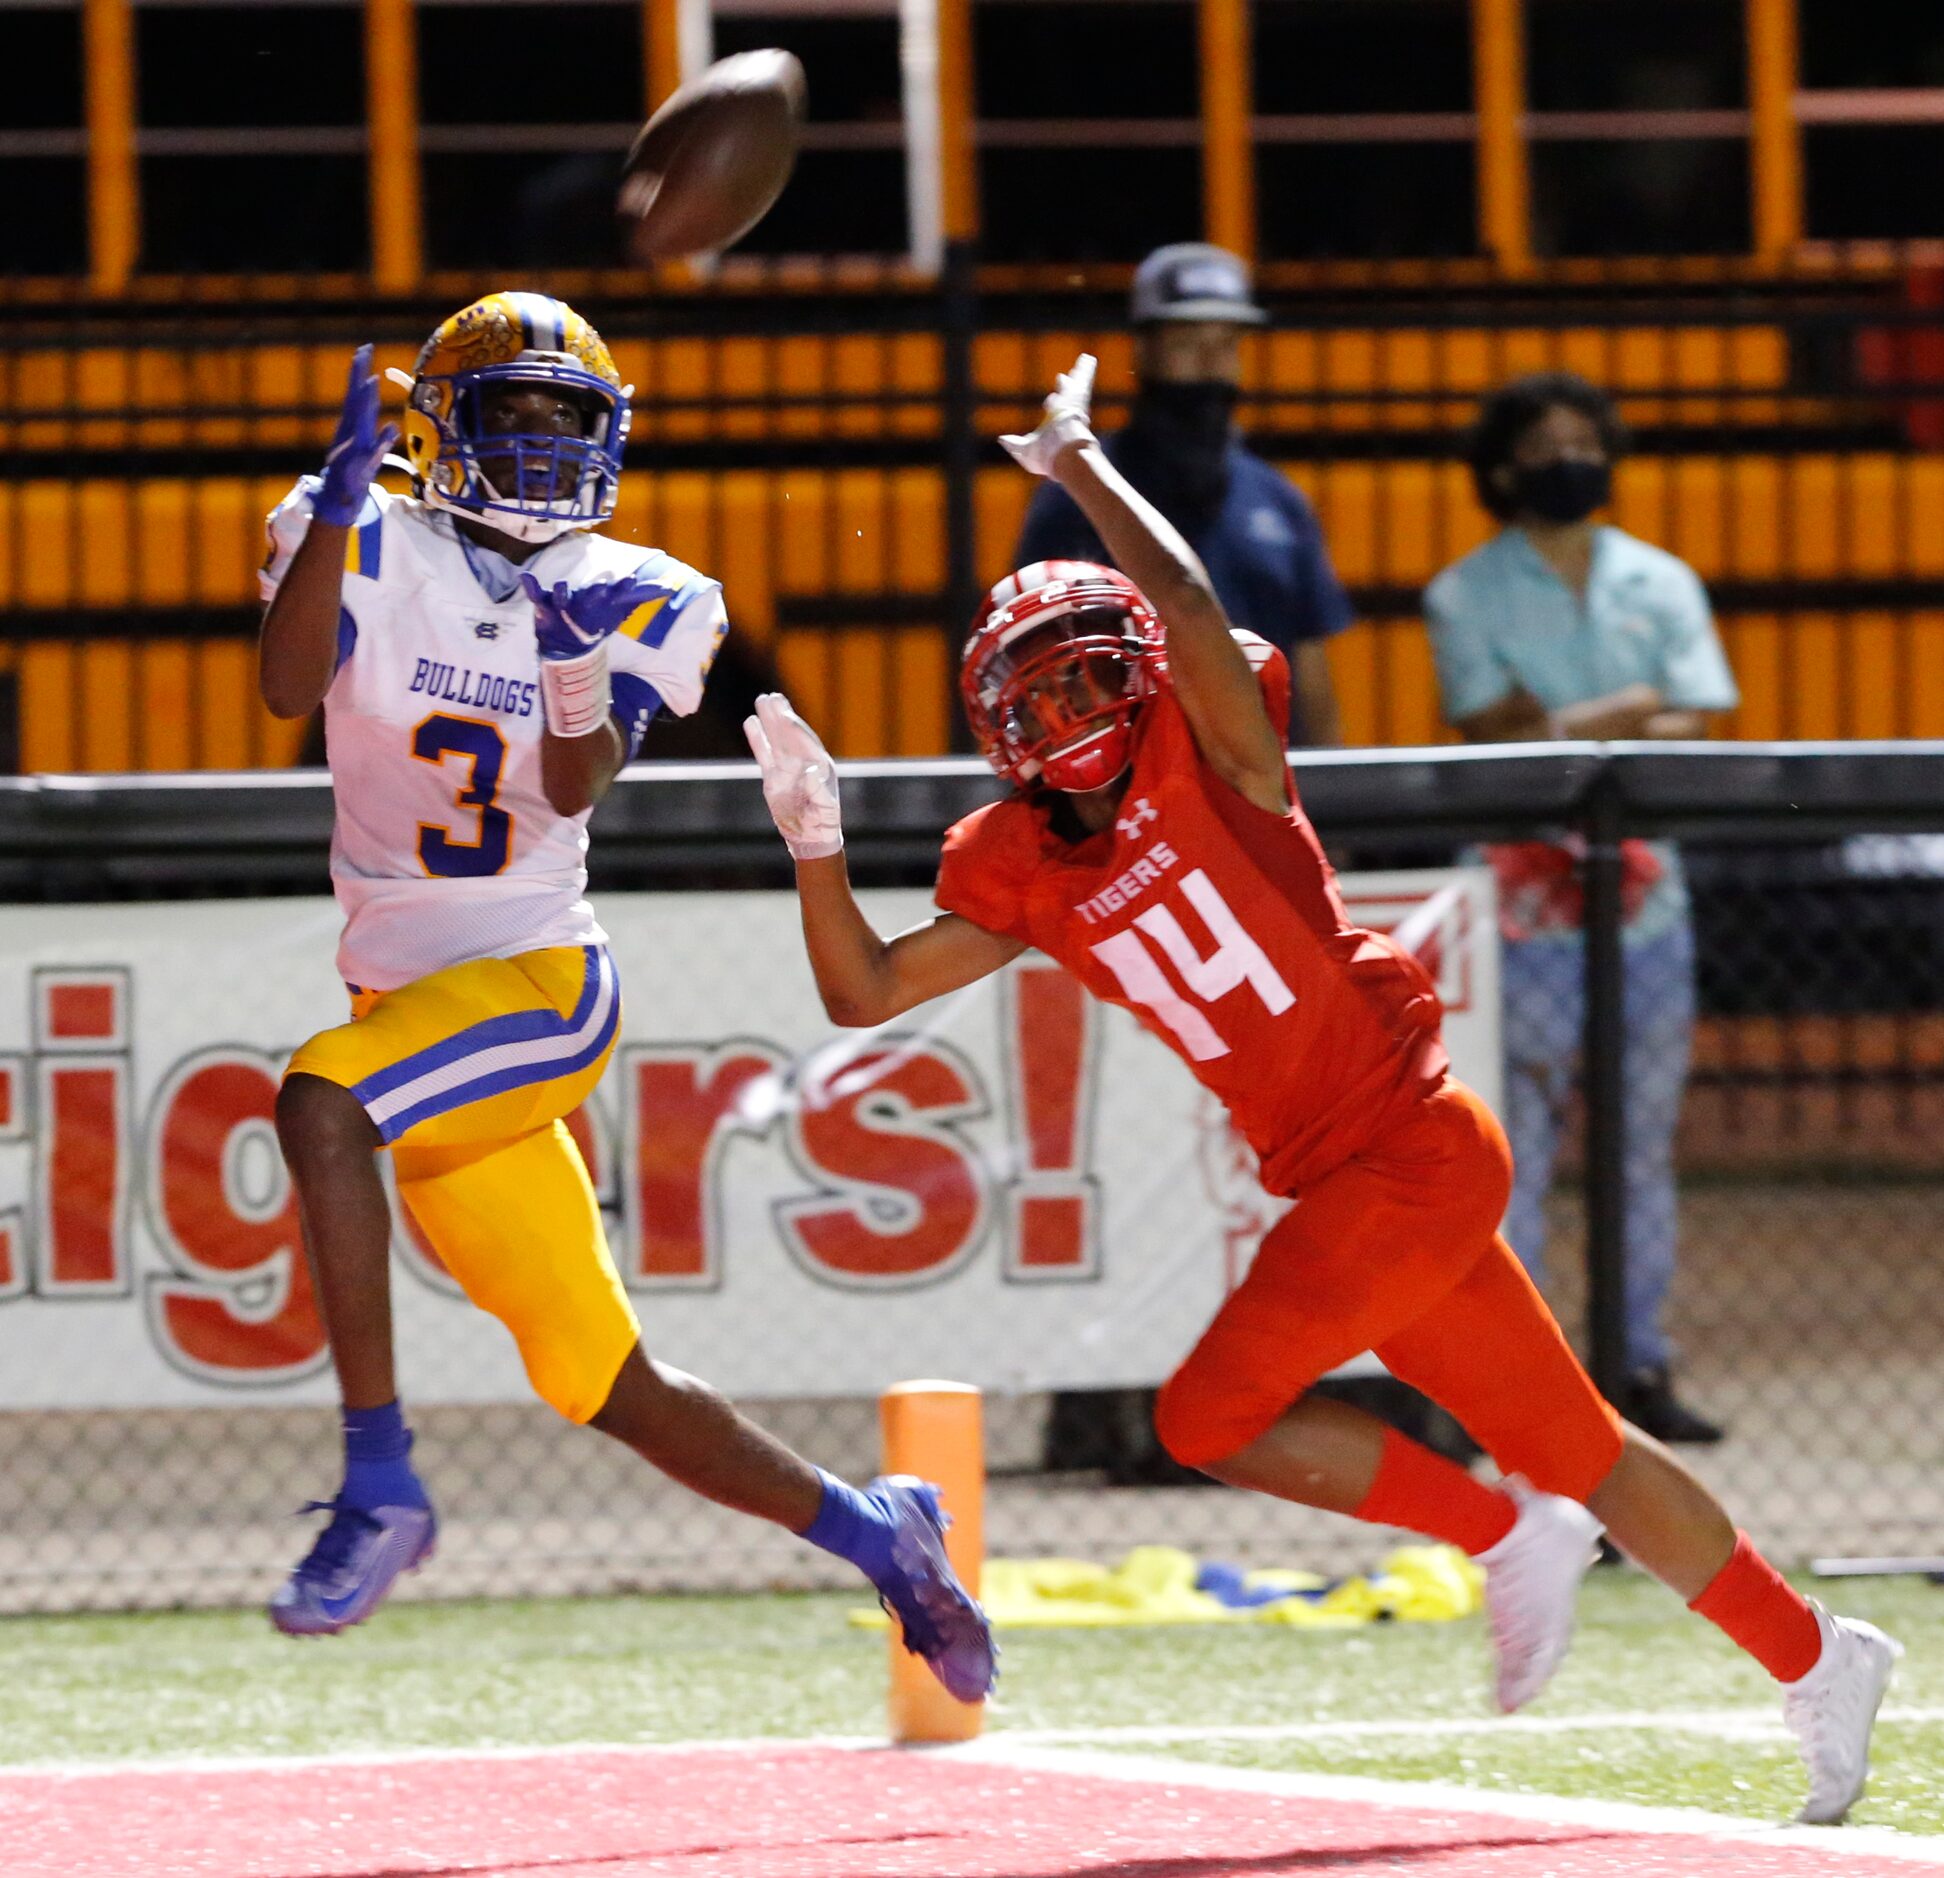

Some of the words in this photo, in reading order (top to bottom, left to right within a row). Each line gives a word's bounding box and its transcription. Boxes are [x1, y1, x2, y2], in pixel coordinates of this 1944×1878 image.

[409, 657, 538, 717] BULLDOGS
[409, 711, 516, 879] 3
[1073, 841, 1179, 924] TIGERS
[1088, 867, 1297, 1062] 14
